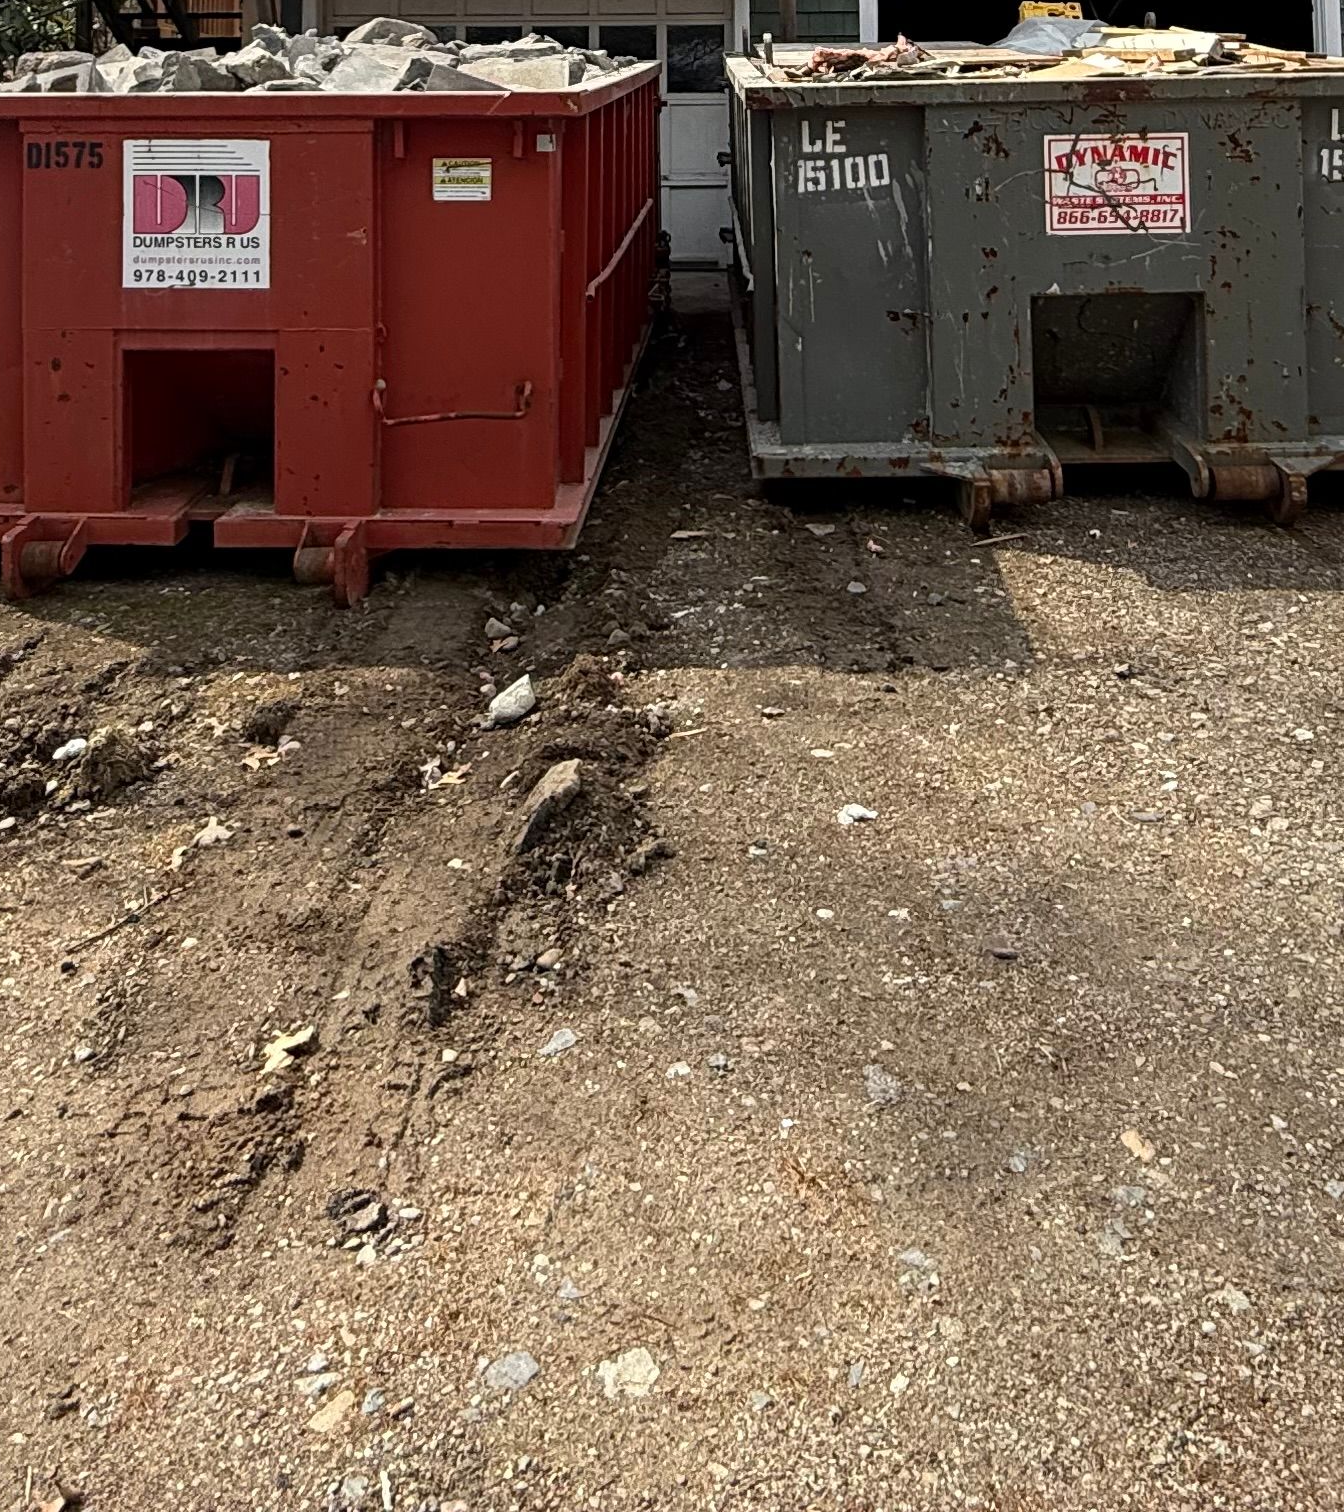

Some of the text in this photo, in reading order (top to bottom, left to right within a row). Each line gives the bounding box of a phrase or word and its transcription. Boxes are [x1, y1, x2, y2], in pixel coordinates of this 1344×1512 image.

[801, 120, 847, 153] LE
[1054, 144, 1178, 172] DYNAMIC
[797, 153, 891, 193] 15100
[1052, 194, 1184, 206] WASTE STEMS, INC.
[132, 236, 260, 249] DUMPSTERS R US
[132, 255, 261, 266] dumpstersrusinc.com
[133, 269, 261, 283] 978-409-2111
